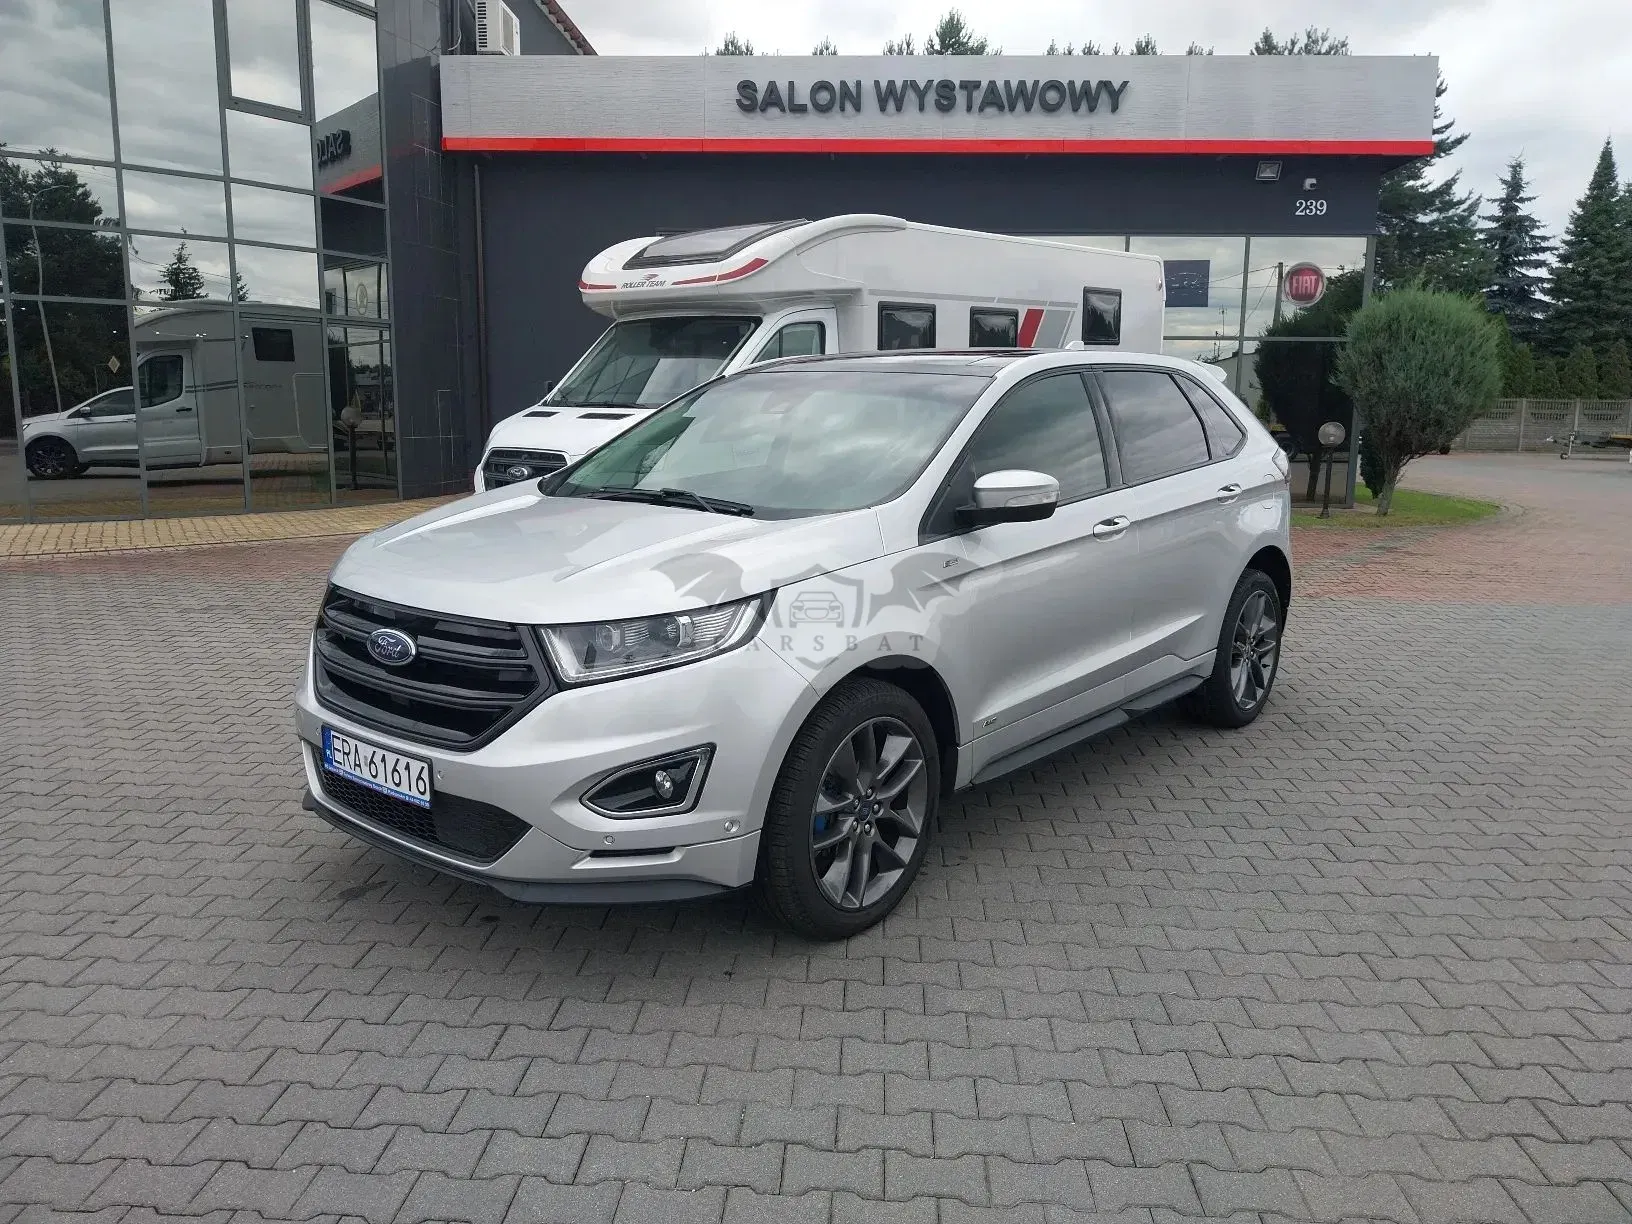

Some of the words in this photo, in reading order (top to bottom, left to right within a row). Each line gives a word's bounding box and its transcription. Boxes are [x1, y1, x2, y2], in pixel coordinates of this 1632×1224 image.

[736, 79, 862, 113] SALON
[873, 79, 1129, 113] WYSTAWOWY
[1295, 199, 1327, 216] 239
[621, 281, 646, 289] ROLLER
[646, 280, 666, 288] TEAM
[1292, 275, 1318, 294] FIAT
[374, 635, 402, 658] Ford
[331, 734, 362, 775] ERA
[368, 750, 427, 796] 61616
